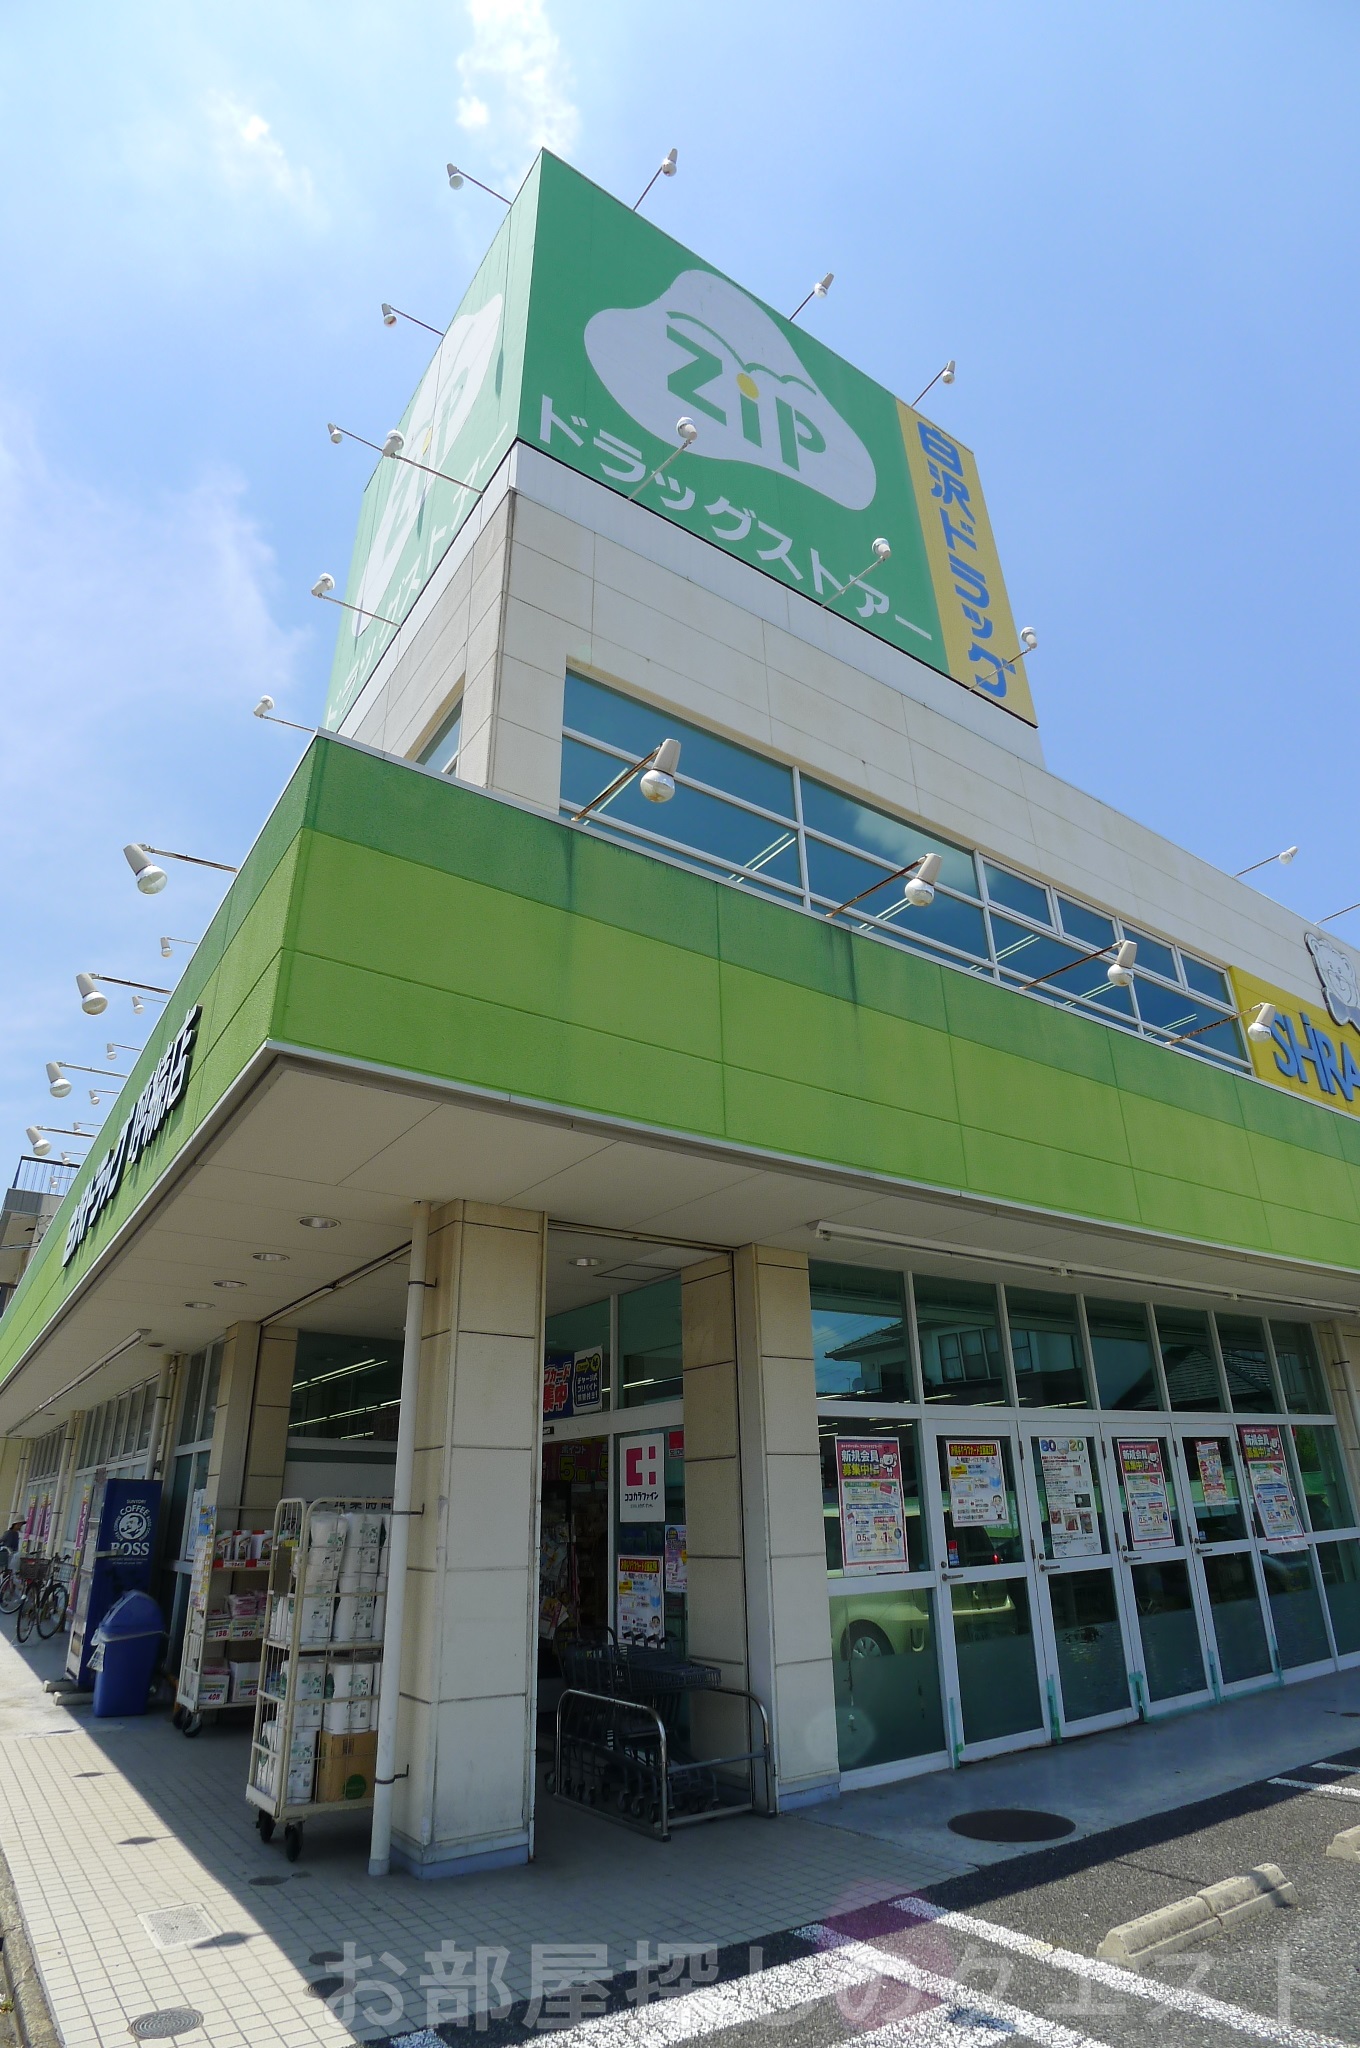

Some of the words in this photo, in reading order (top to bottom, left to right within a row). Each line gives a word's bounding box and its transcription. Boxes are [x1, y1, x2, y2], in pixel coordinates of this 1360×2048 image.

[539, 393, 932, 640] ドラッグストアー
[917, 420, 1016, 698] 白沢ドラッグ
[1069, 1440, 1084, 1451] 20
[841, 1449, 879, 1462] 新規会員
[624, 1491, 659, 1502] ココカラファイン
[120, 1504, 150, 1516] COFFEE
[110, 1542, 150, 1556] BOSS
